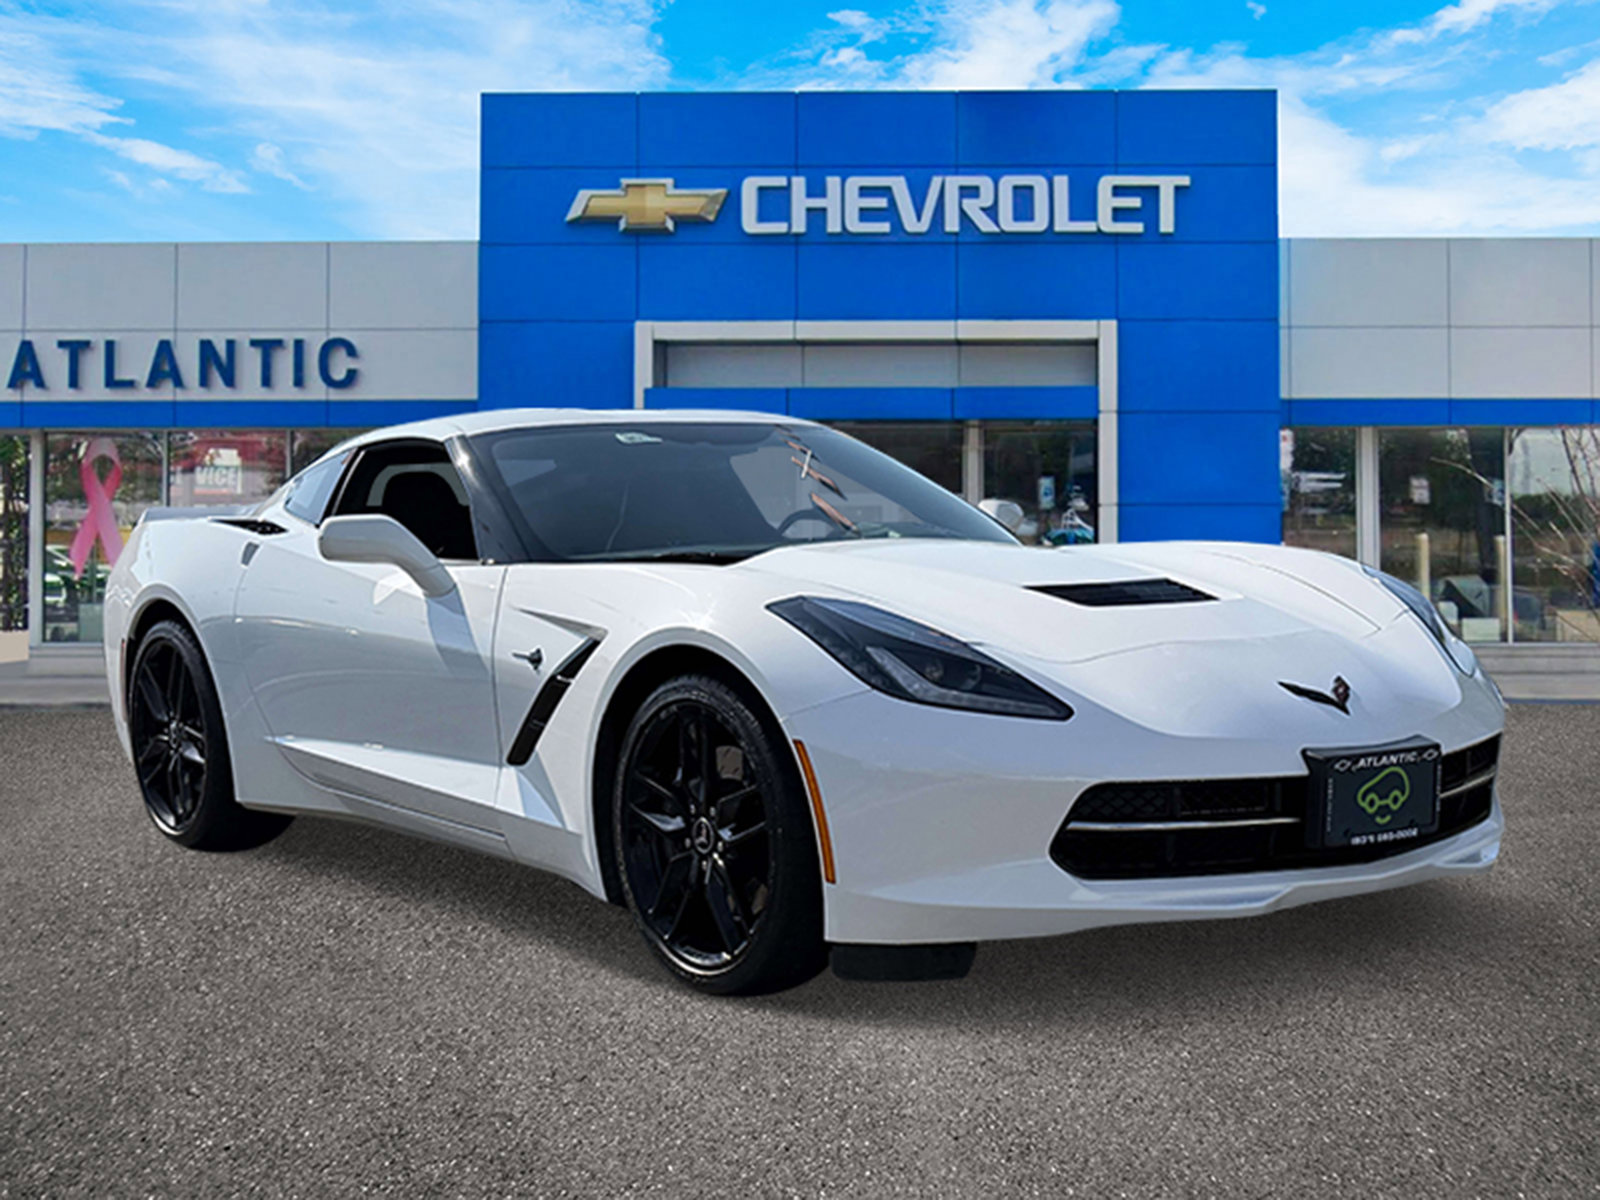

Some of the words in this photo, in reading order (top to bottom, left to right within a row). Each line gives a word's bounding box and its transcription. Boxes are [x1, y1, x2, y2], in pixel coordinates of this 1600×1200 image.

[741, 174, 1191, 235] CHEVROLET
[7, 337, 360, 390] ATLANTIC
[1357, 752, 1418, 768] ATLANTIC
